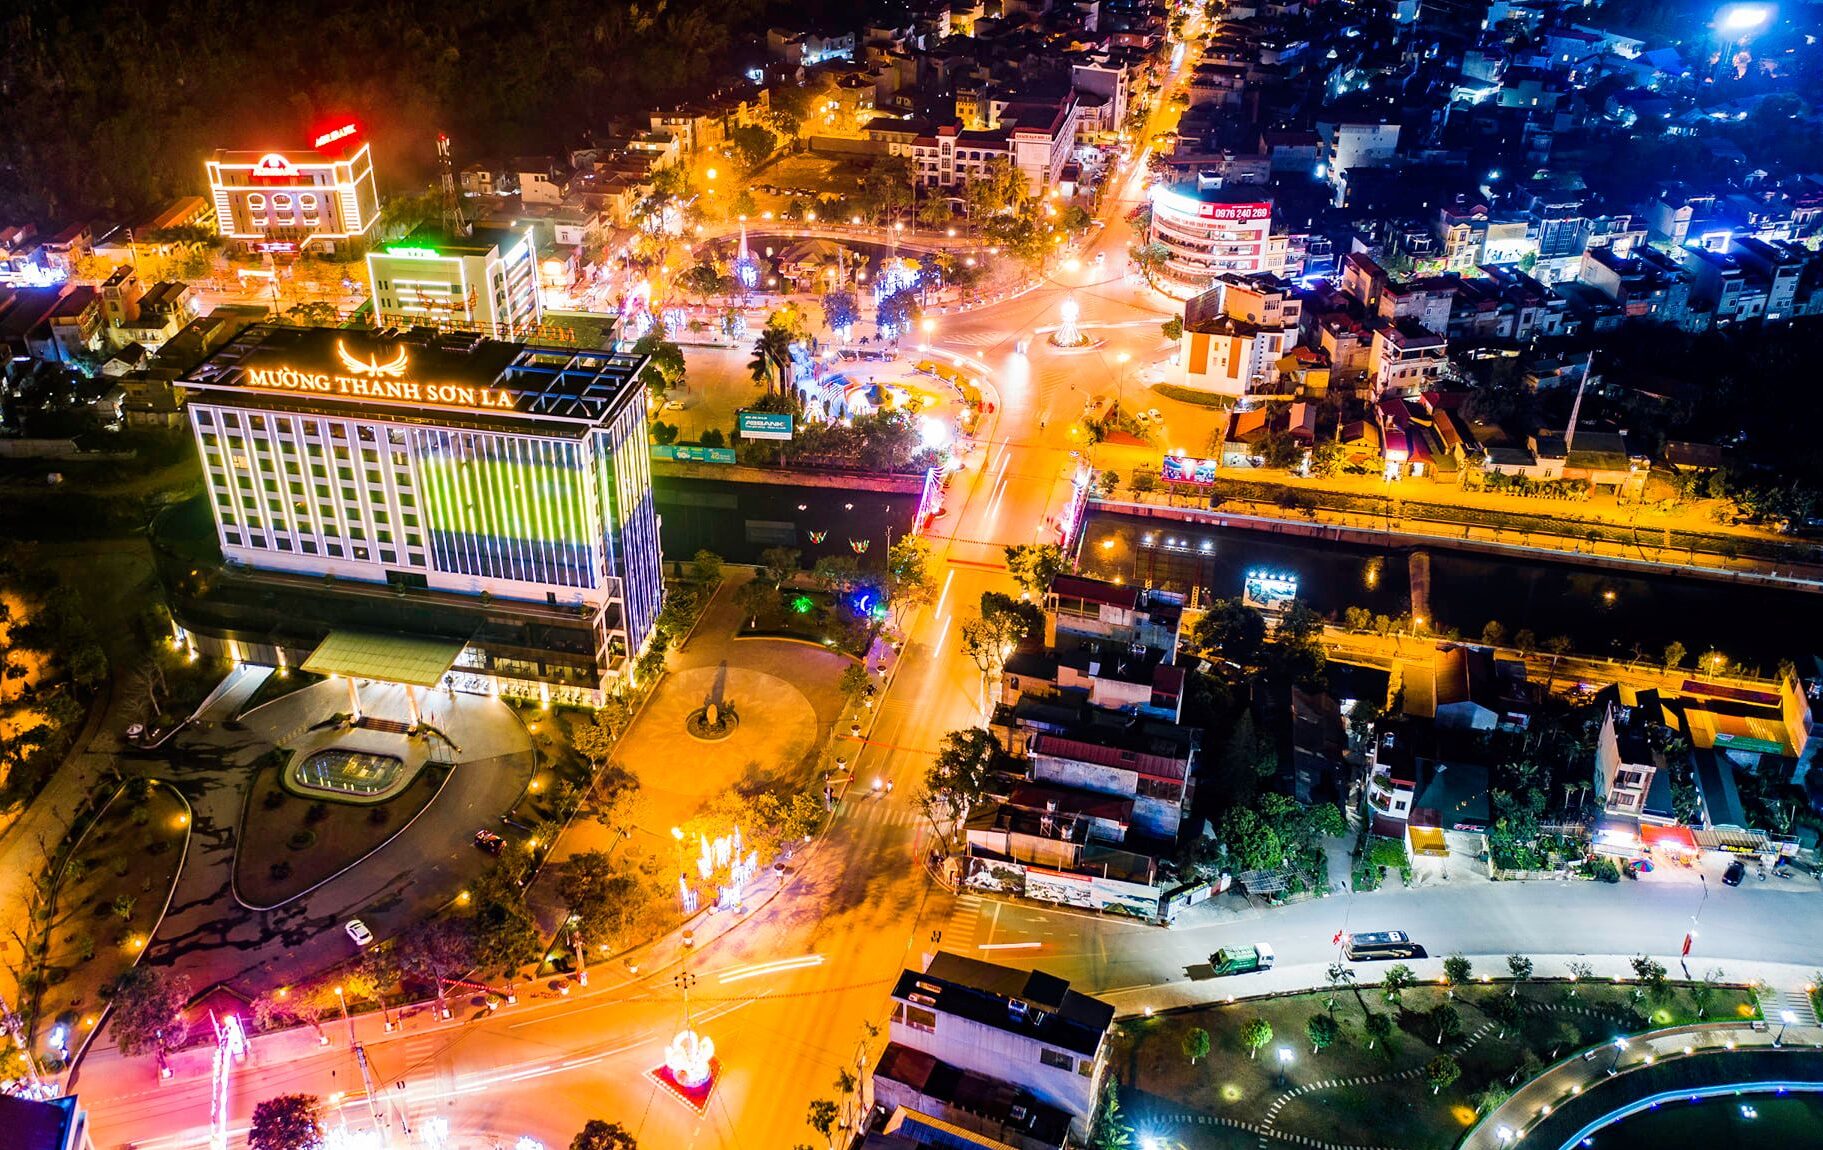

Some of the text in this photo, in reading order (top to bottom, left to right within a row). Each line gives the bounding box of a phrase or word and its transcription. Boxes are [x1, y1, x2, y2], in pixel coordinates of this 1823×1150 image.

[1215, 208, 1267, 218] 0976 240 269
[249, 366, 515, 408] MƯỜNG THANH SƠN LA
